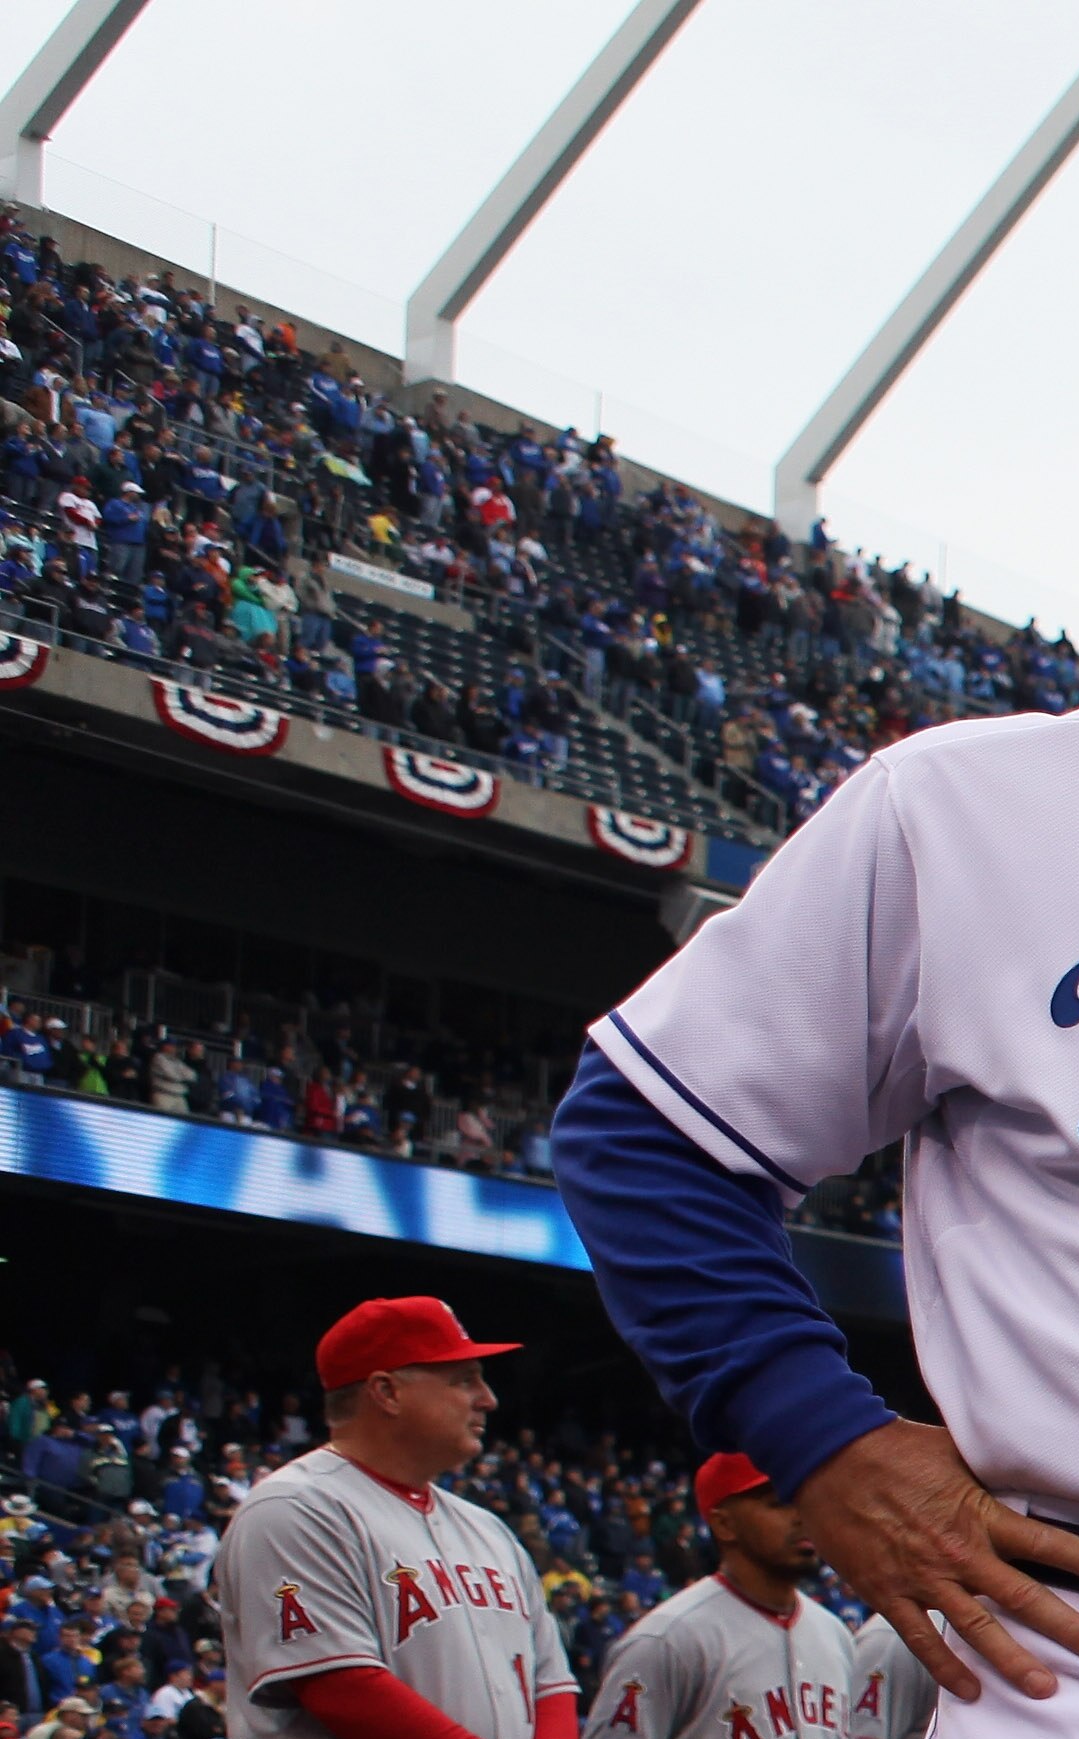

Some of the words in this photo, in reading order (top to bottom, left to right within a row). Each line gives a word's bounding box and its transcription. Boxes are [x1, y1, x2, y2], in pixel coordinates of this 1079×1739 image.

[274, 1579, 320, 1643] A
[383, 1557, 531, 1647] ANGEL
[609, 1678, 645, 1733] A
[856, 1669, 886, 1717] A
